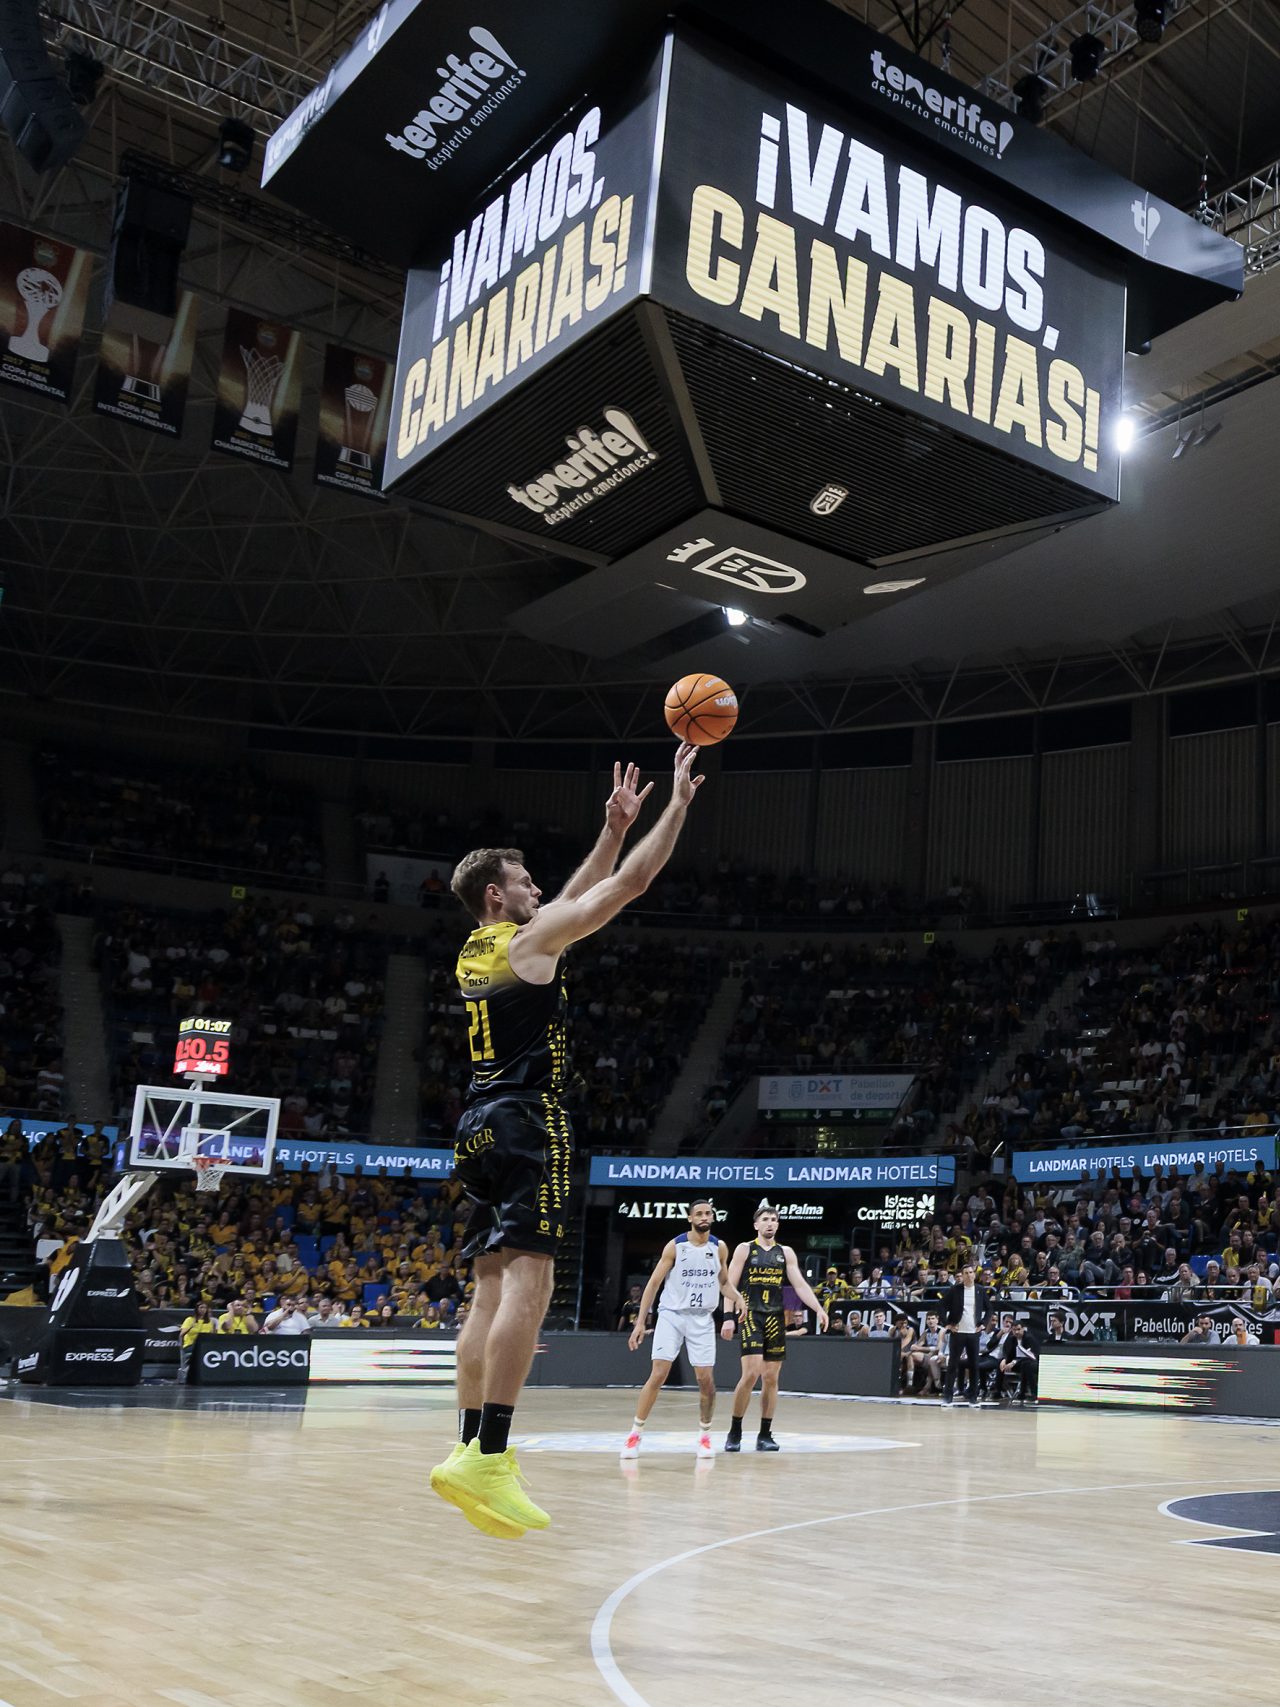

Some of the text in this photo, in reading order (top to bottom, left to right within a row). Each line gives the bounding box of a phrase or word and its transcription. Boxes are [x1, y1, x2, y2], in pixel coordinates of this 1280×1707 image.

[385, 26, 527, 159] tenerife!
[870, 49, 1014, 160] tenerife!
[427, 76, 522, 170] despierta emociones
[871, 80, 995, 156] despierta emociones
[432, 106, 606, 343] ¡VAMOS,
[756, 102, 1060, 351] ¡VAMOS,
[397, 194, 634, 460] CANARIAS!
[686, 184, 1100, 472] CANARIAS!
[508, 407, 658, 514] tenerife!
[544, 491, 594, 526] despierta
[194, 1018, 232, 1033] 01:07
[465, 1000, 495, 1062] 21
[190, 1038, 230, 1062] 0.5
[294, 1150, 355, 1165] HOTELS
[365, 1154, 441, 1170] LANDMAR
[1029, 1148, 1258, 1172] LANDMAR HOTELS LANDMAR HOTELS
[608, 1164, 938, 1181] LANDMAR HOTELS LANDMAR HOTELS
[789, 1203, 825, 1215] Palma
[857, 1206, 915, 1221] Canarias
[884, 1194, 915, 1209] Islas
[682, 1269, 708, 1277] asisa
[689, 1293, 703, 1308] 24
[1134, 1317, 1186, 1333] Pabellón
[65, 1352, 115, 1362] EXPRESS
[203, 1345, 309, 1369] endesa
